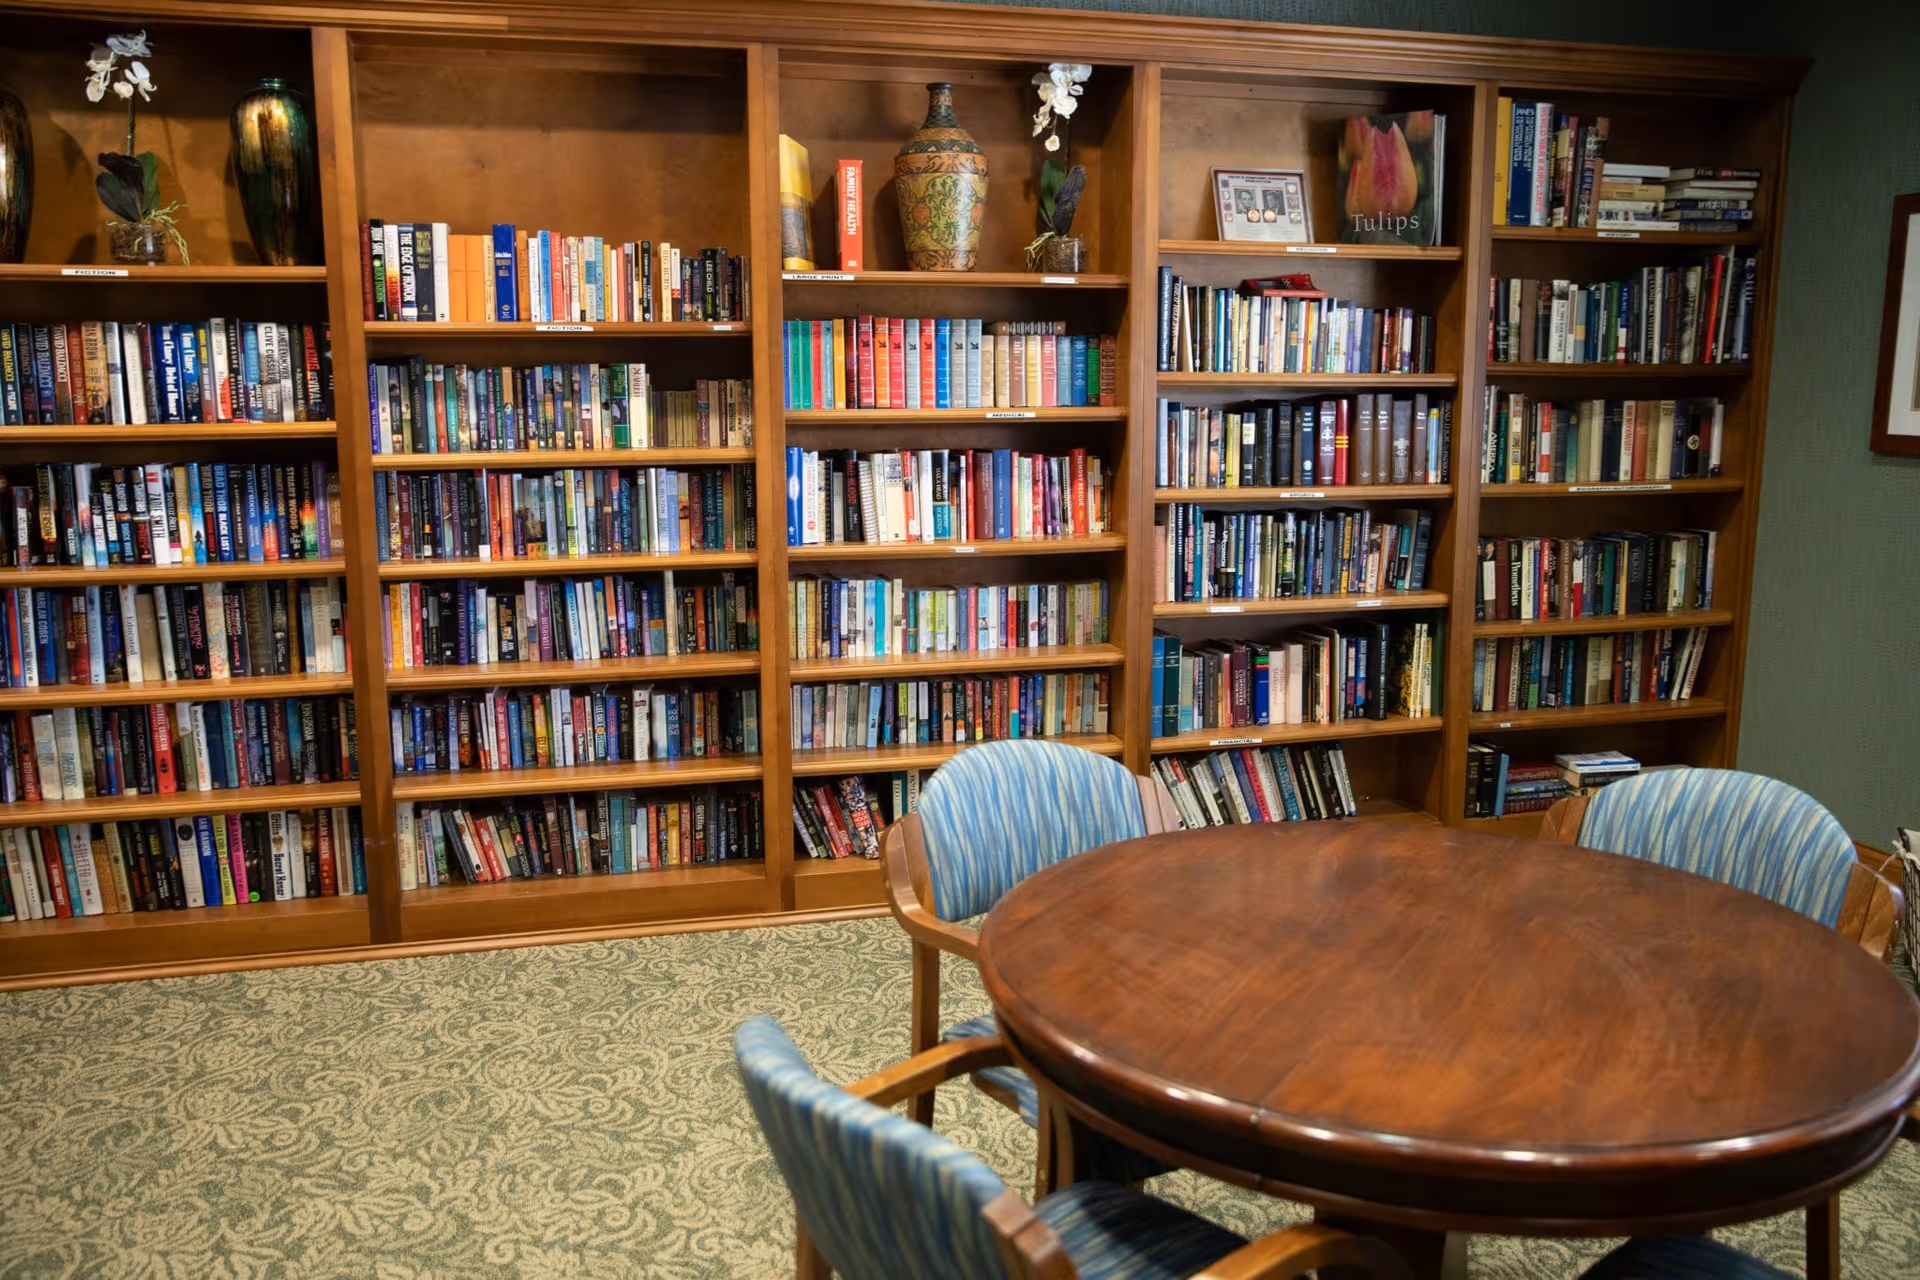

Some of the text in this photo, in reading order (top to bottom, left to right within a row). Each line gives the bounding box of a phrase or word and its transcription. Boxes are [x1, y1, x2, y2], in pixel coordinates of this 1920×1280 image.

[846, 166, 856, 235] FAMILY HEALTH
[371, 227, 383, 241] JOHN
[1351, 212, 1419, 235] Tulips
[373, 243, 384, 255] SAUL
[401, 233, 414, 301] THE EDGE OF HONOR
[1, 329, 12, 349] DAVID
[162, 326, 173, 339] Tom
[278, 331, 287, 347] JANET
[34, 328, 52, 388] DAVID BALDACCI
[54, 327, 68, 382] DAVID BALDACCI
[86, 337, 97, 361] BROWN
[162, 341, 174, 365] Clancy
[182, 332, 197, 374] Tom Clancy
[229, 325, 238, 368] DISCLOSURE
[264, 326, 275, 382] CLIVE CUSSLER
[3, 351, 14, 382] BALDACCI
[306, 350, 320, 404] KING REVIVAL
[167, 392, 177, 415] Honor
[1489, 432, 1497, 473] AMERICA
[103, 493, 114, 510] JAMES
[201, 465, 217, 513] BRAD THOR
[286, 467, 298, 530] STUART WOODS
[745, 486, 754, 508] FLYNN
[848, 478, 856, 504] BLOOD
[149, 493, 164, 513] ZADIE
[214, 465, 230, 551] BRAD THOR BLACK LIST
[248, 495, 256, 518] WOODS
[261, 492, 271, 515] WOODS
[277, 493, 285, 516] WOODS
[121, 523, 131, 539] SHOCK
[152, 515, 165, 538] SMITH
[1511, 561, 1520, 606] Prometheus
[36, 592, 49, 644] HARLAN COBEN
[126, 616, 137, 655] Educated
[193, 618, 203, 649] TEMPTING
[696, 805, 704, 830] Griffin
[215, 827, 226, 856] LEE CHILD
[272, 813, 286, 896] Griffin Secret Honor
[320, 837, 330, 859] COBEN
